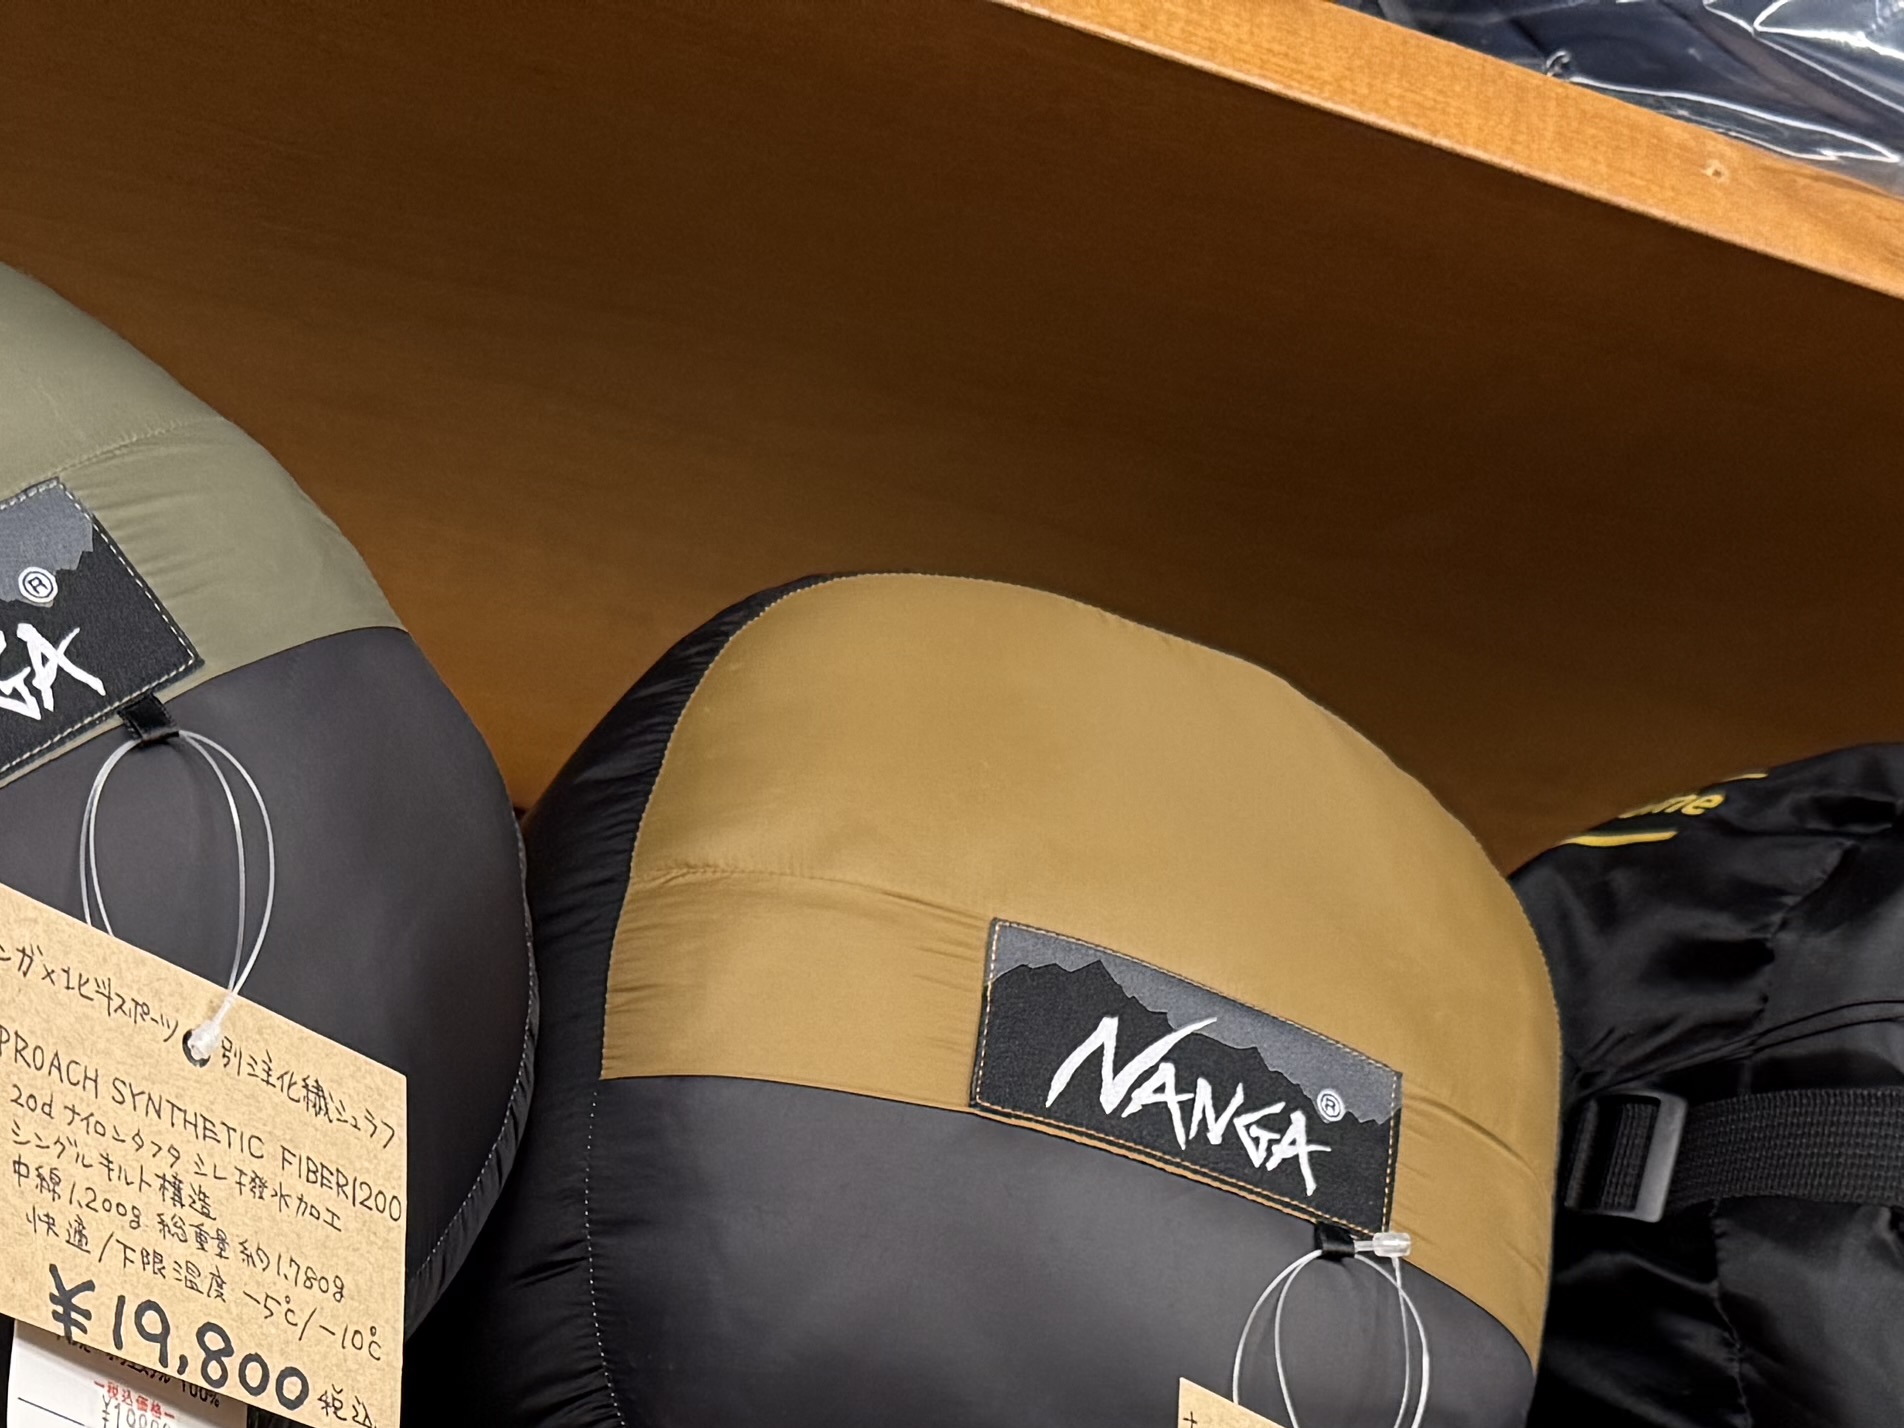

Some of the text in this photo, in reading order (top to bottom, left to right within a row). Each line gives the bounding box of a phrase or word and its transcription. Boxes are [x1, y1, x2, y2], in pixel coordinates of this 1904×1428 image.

[112, 1077, 264, 1160] SYNTHETIC
[1046, 1016, 1331, 1196] NANGA
[49, 1263, 310, 1410] ¥19,800
